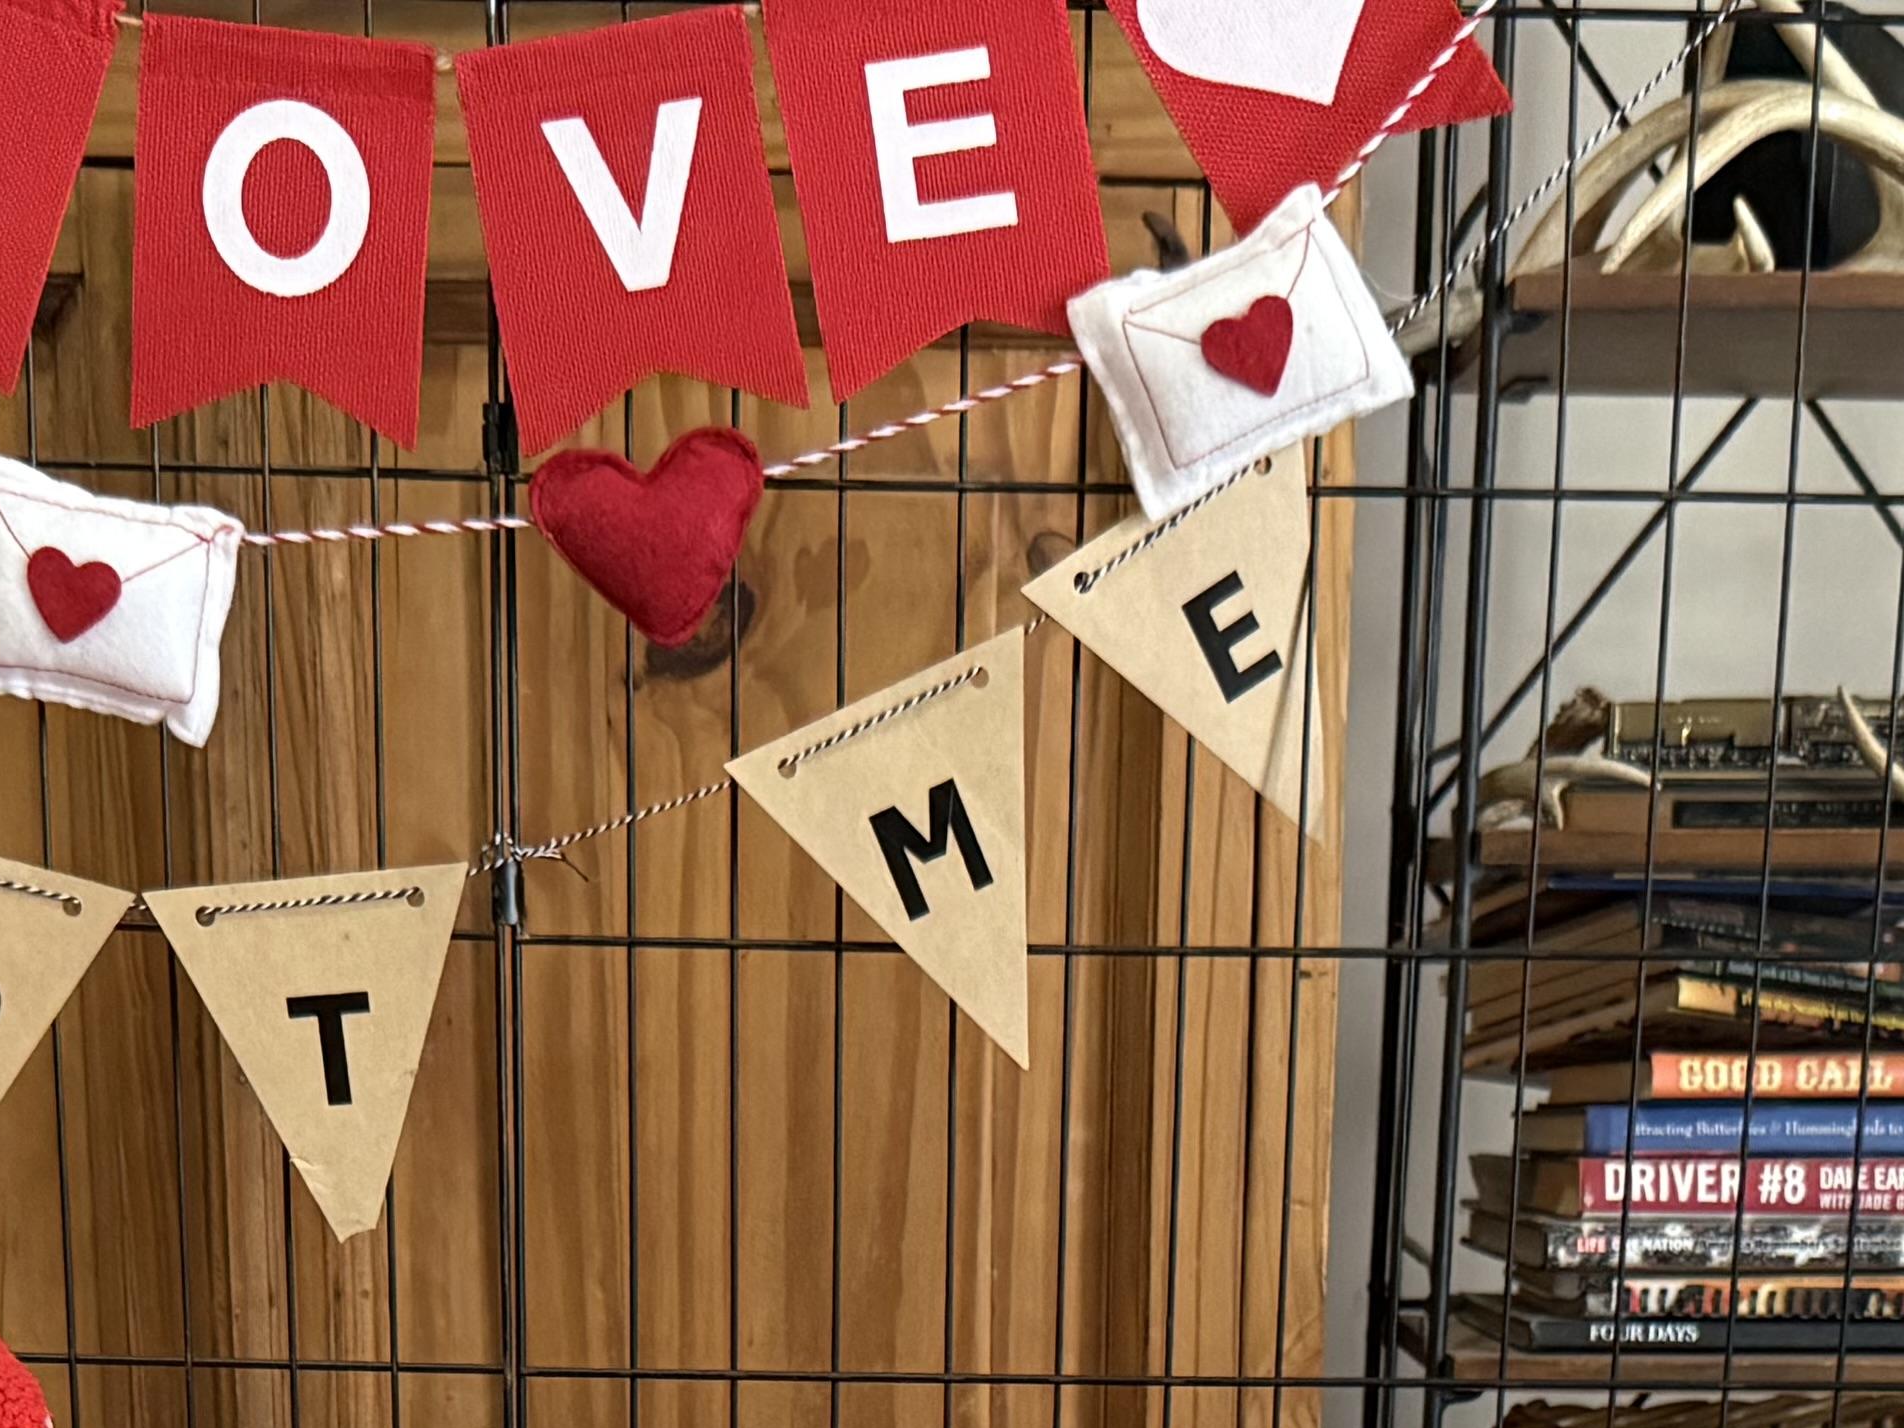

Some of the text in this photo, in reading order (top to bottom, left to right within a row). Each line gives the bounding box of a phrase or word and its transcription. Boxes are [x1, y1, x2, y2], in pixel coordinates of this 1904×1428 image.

[1679, 1058, 1894, 1092] GOOD CALL
[1634, 1120, 1693, 1139] ttracting
[1785, 1116, 1885, 1139] Hummingrds
[1604, 1161, 1807, 1205] DRIVER #8
[1576, 1237, 1607, 1254] LIFE
[1642, 1237, 1694, 1253] NATION
[1589, 1321, 1700, 1343] FOUR DAYS
